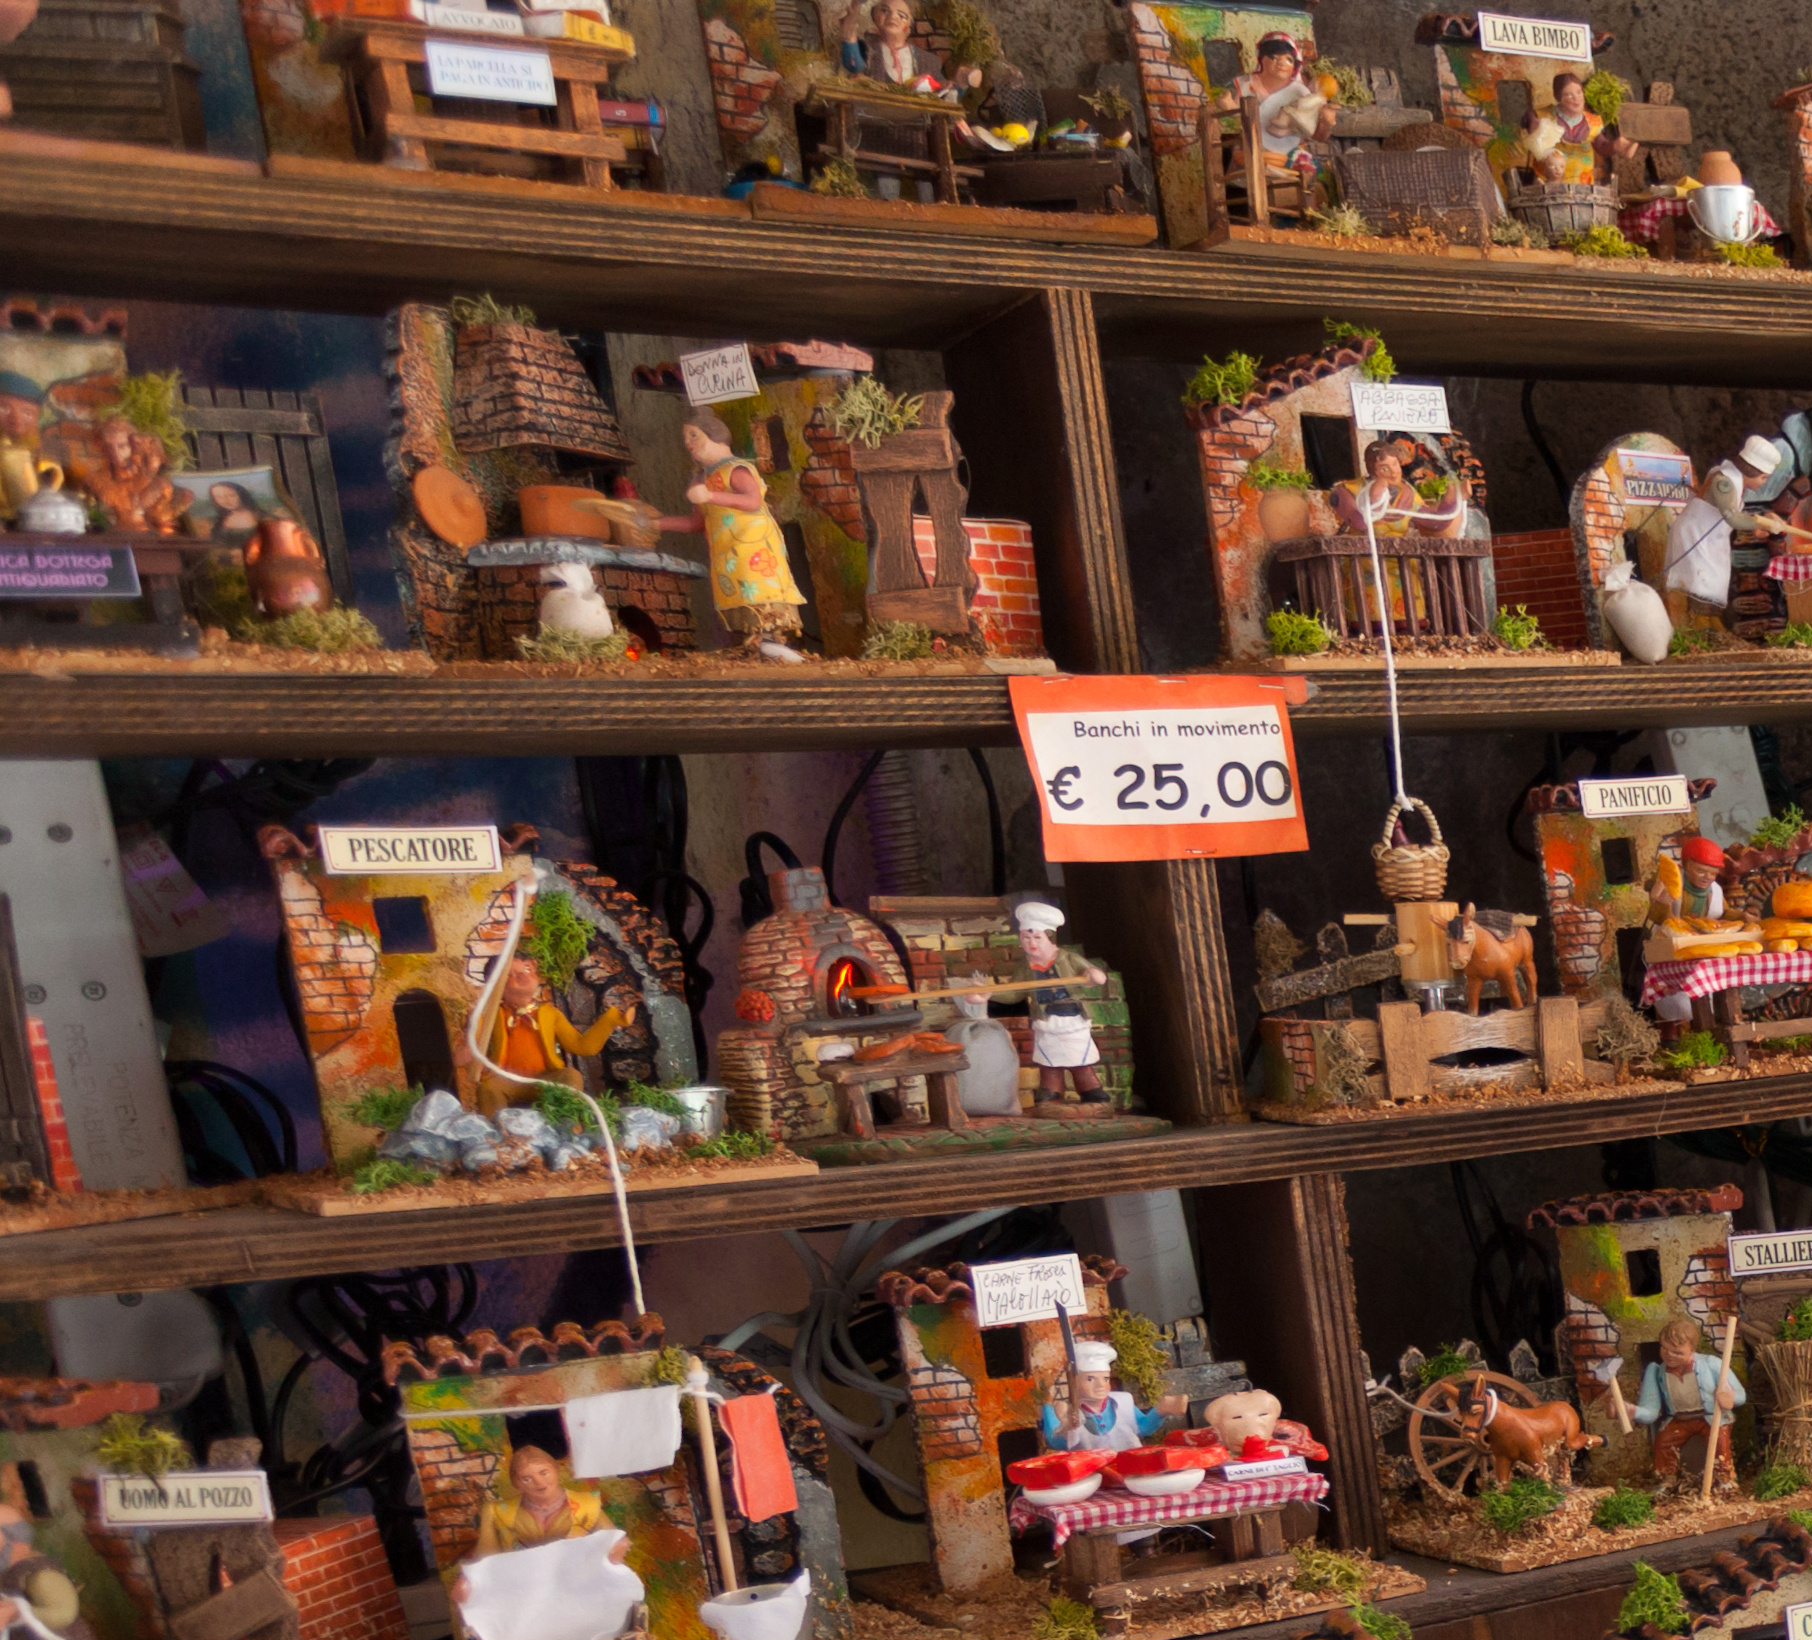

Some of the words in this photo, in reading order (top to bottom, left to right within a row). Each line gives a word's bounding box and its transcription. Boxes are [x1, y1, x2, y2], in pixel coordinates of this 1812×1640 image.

[1491, 20, 1528, 45] LAVA
[1533, 26, 1580, 51] BIMBO
[687, 353, 731, 378] DONNA
[1360, 389, 1442, 405] ABBASSA
[36, 554, 114, 569] BOTTEGA
[1073, 720, 1142, 740] Banchi
[1151, 722, 1168, 738] in
[1177, 719, 1281, 740] movimento
[1046, 765, 1084, 812] €
[1113, 759, 1294, 819] 25,00
[1599, 785, 1672, 809] PANIFICIO
[349, 837, 479, 864] PESCATORE
[983, 1270, 1022, 1289] CARNE
[121, 1486, 170, 1511] UOMO
[174, 1487, 198, 1509] AL
[201, 1486, 254, 1509] POZZO
